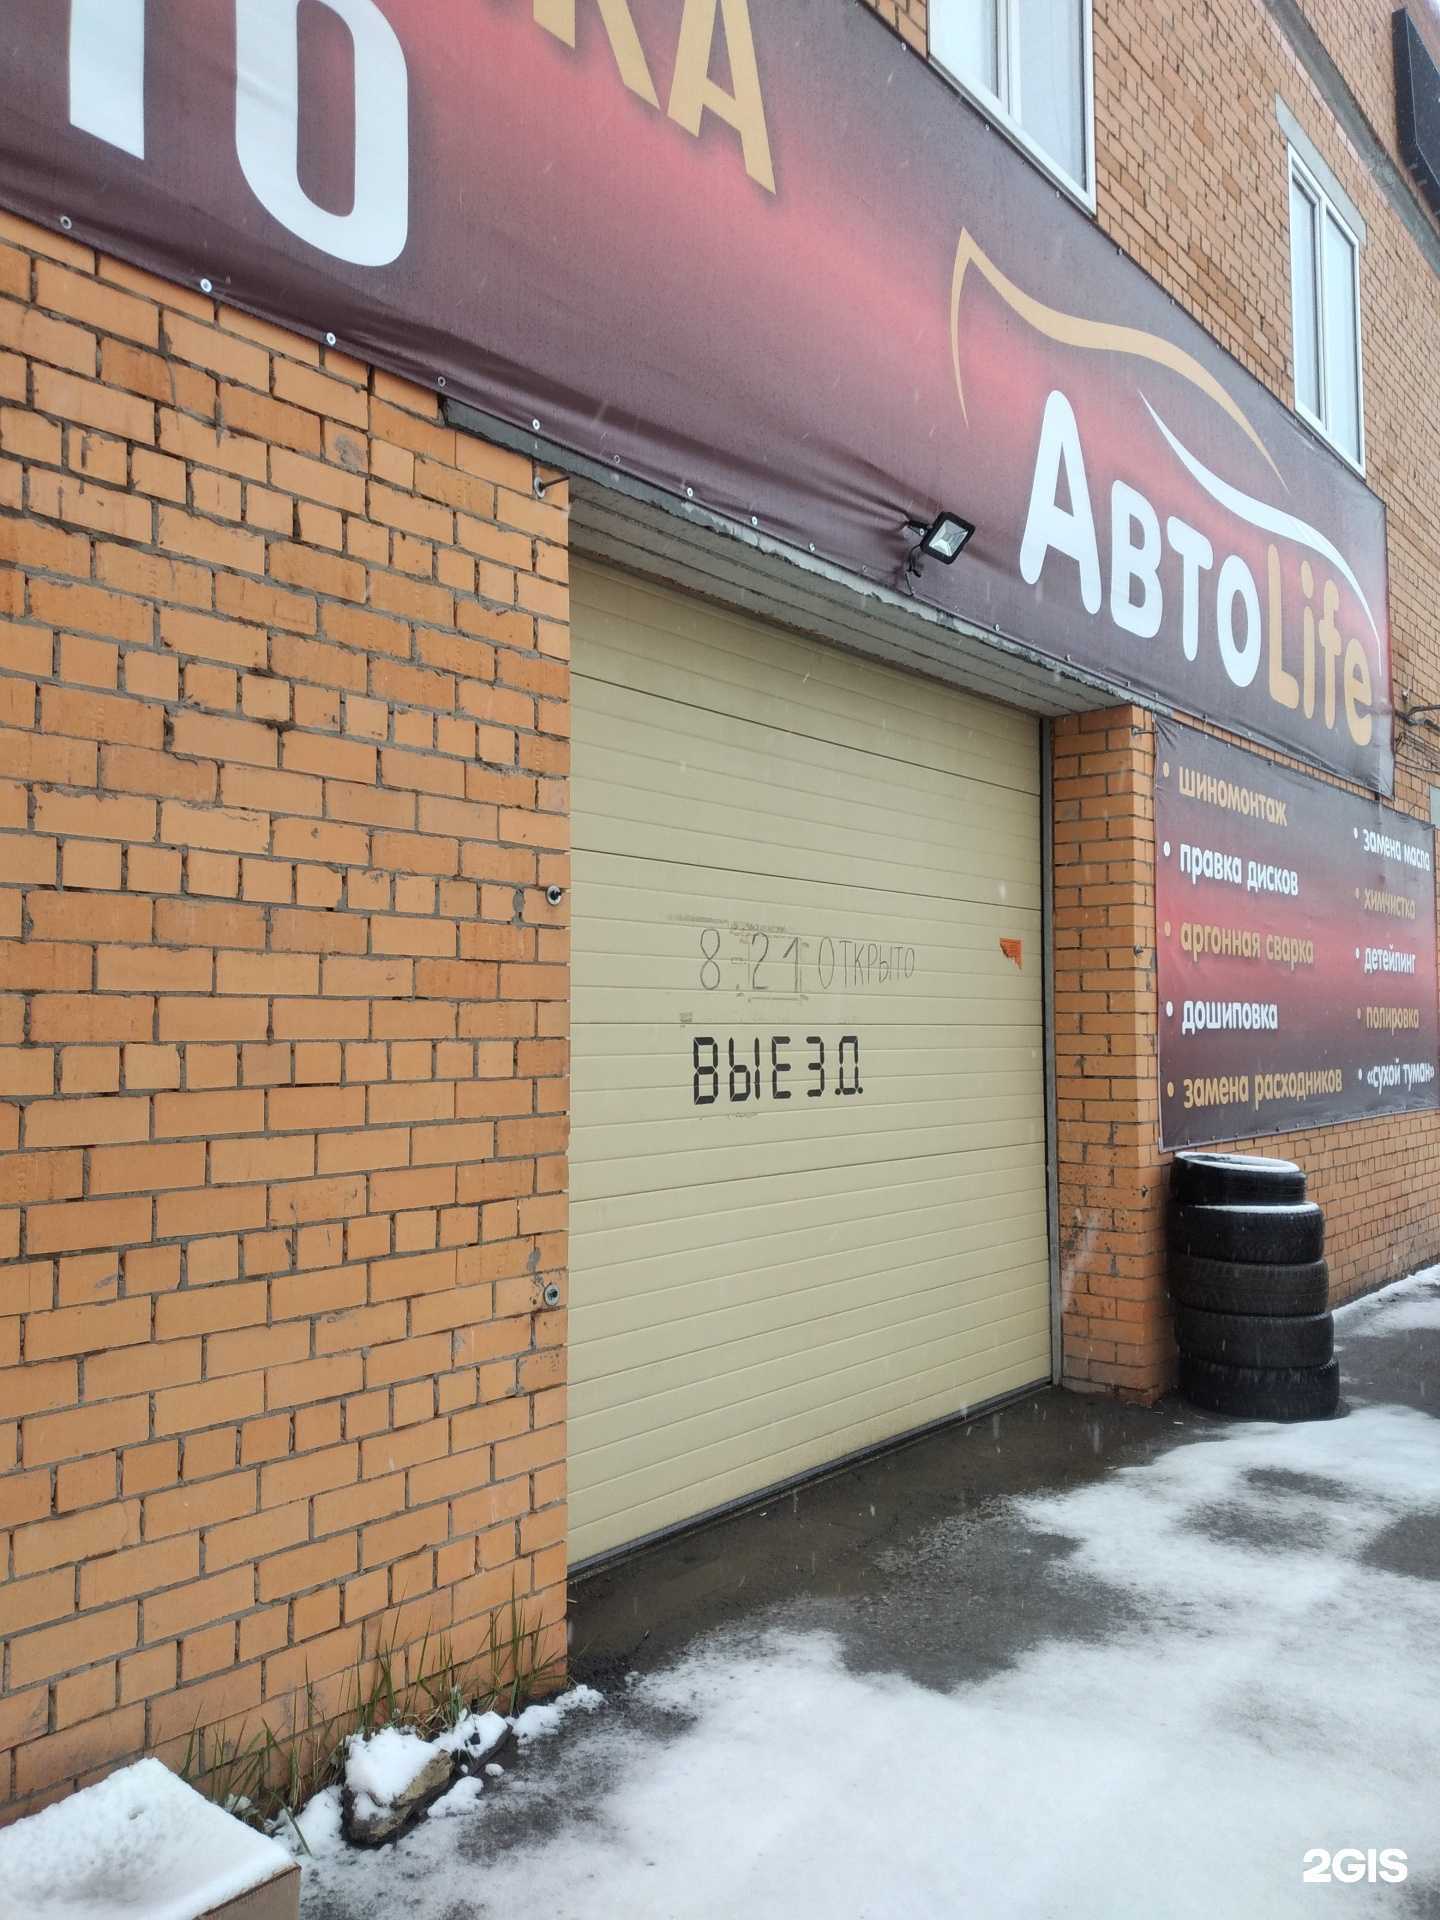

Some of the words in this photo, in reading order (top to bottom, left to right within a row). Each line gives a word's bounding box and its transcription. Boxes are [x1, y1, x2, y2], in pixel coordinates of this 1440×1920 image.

[1179, 766, 1288, 826] шиномонтаж
[1180, 843, 1242, 884] правка
[1247, 860, 1298, 896] дисков
[1363, 828, 1401, 861] замена
[1404, 843, 1430, 872] масла
[1364, 887, 1416, 920] химчистка
[818, 935, 915, 989] ОТКРЫТО
[1181, 922, 1261, 962] аргонная
[1266, 934, 1314, 971] сварка
[1364, 944, 1416, 974] детейлинг
[1182, 1000, 1278, 1035] дошиповка
[1366, 1006, 1419, 1036] полировка
[693, 1035, 864, 1105] ВЫЕЗД
[1183, 1075, 1249, 1109] замена
[1254, 1069, 1342, 1111] расходников
